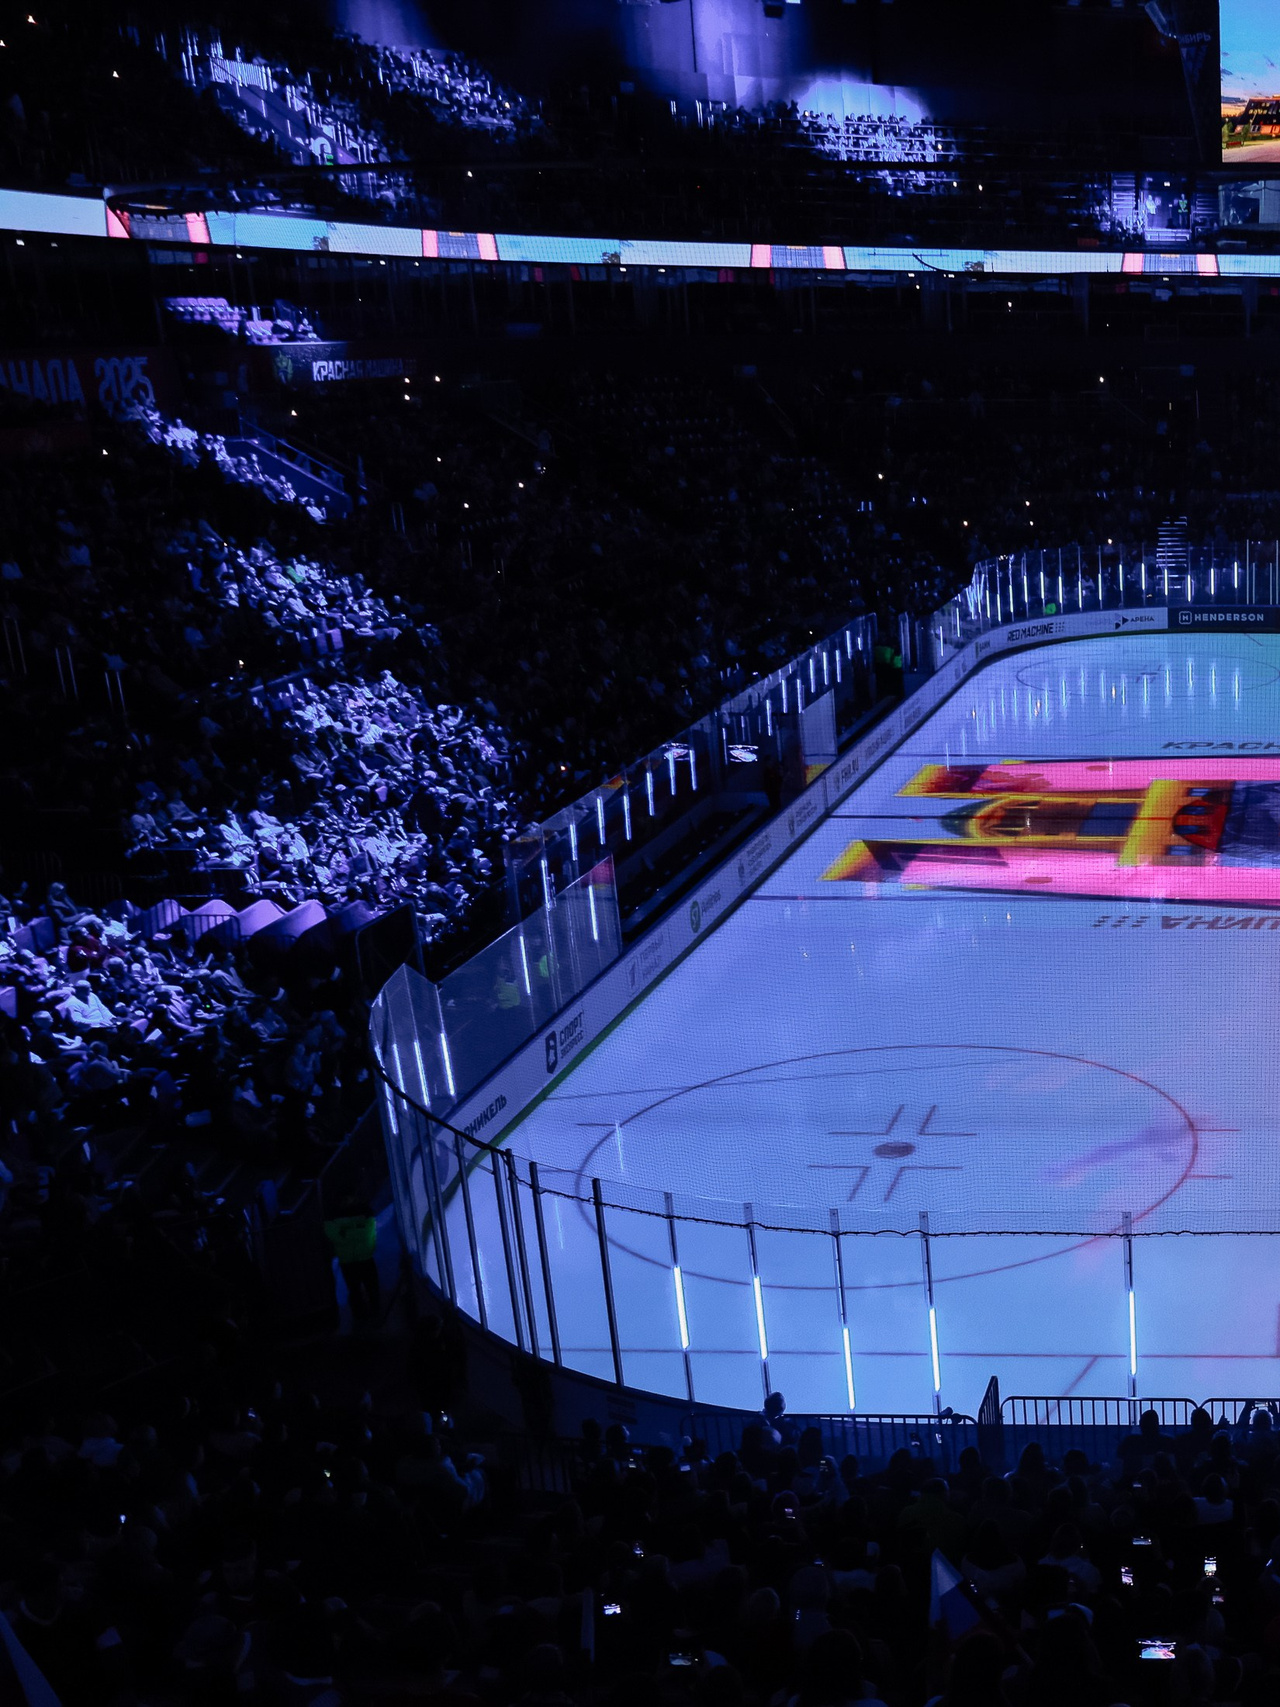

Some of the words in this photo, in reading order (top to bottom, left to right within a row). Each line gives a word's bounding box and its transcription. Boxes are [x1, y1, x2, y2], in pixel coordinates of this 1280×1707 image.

[1178, 32, 1212, 44] ИБИРЬ
[312, 359, 364, 382] КРАСНАЯ
[94, 356, 156, 422] 2025
[1194, 613, 1264, 622] HENDERSON
[1006, 628, 1021, 642] RED
[1021, 623, 1054, 638] MACHINE
[560, 1011, 583, 1047] СПОРТ
[462, 1094, 508, 1139] РНИКЕЛЬ
